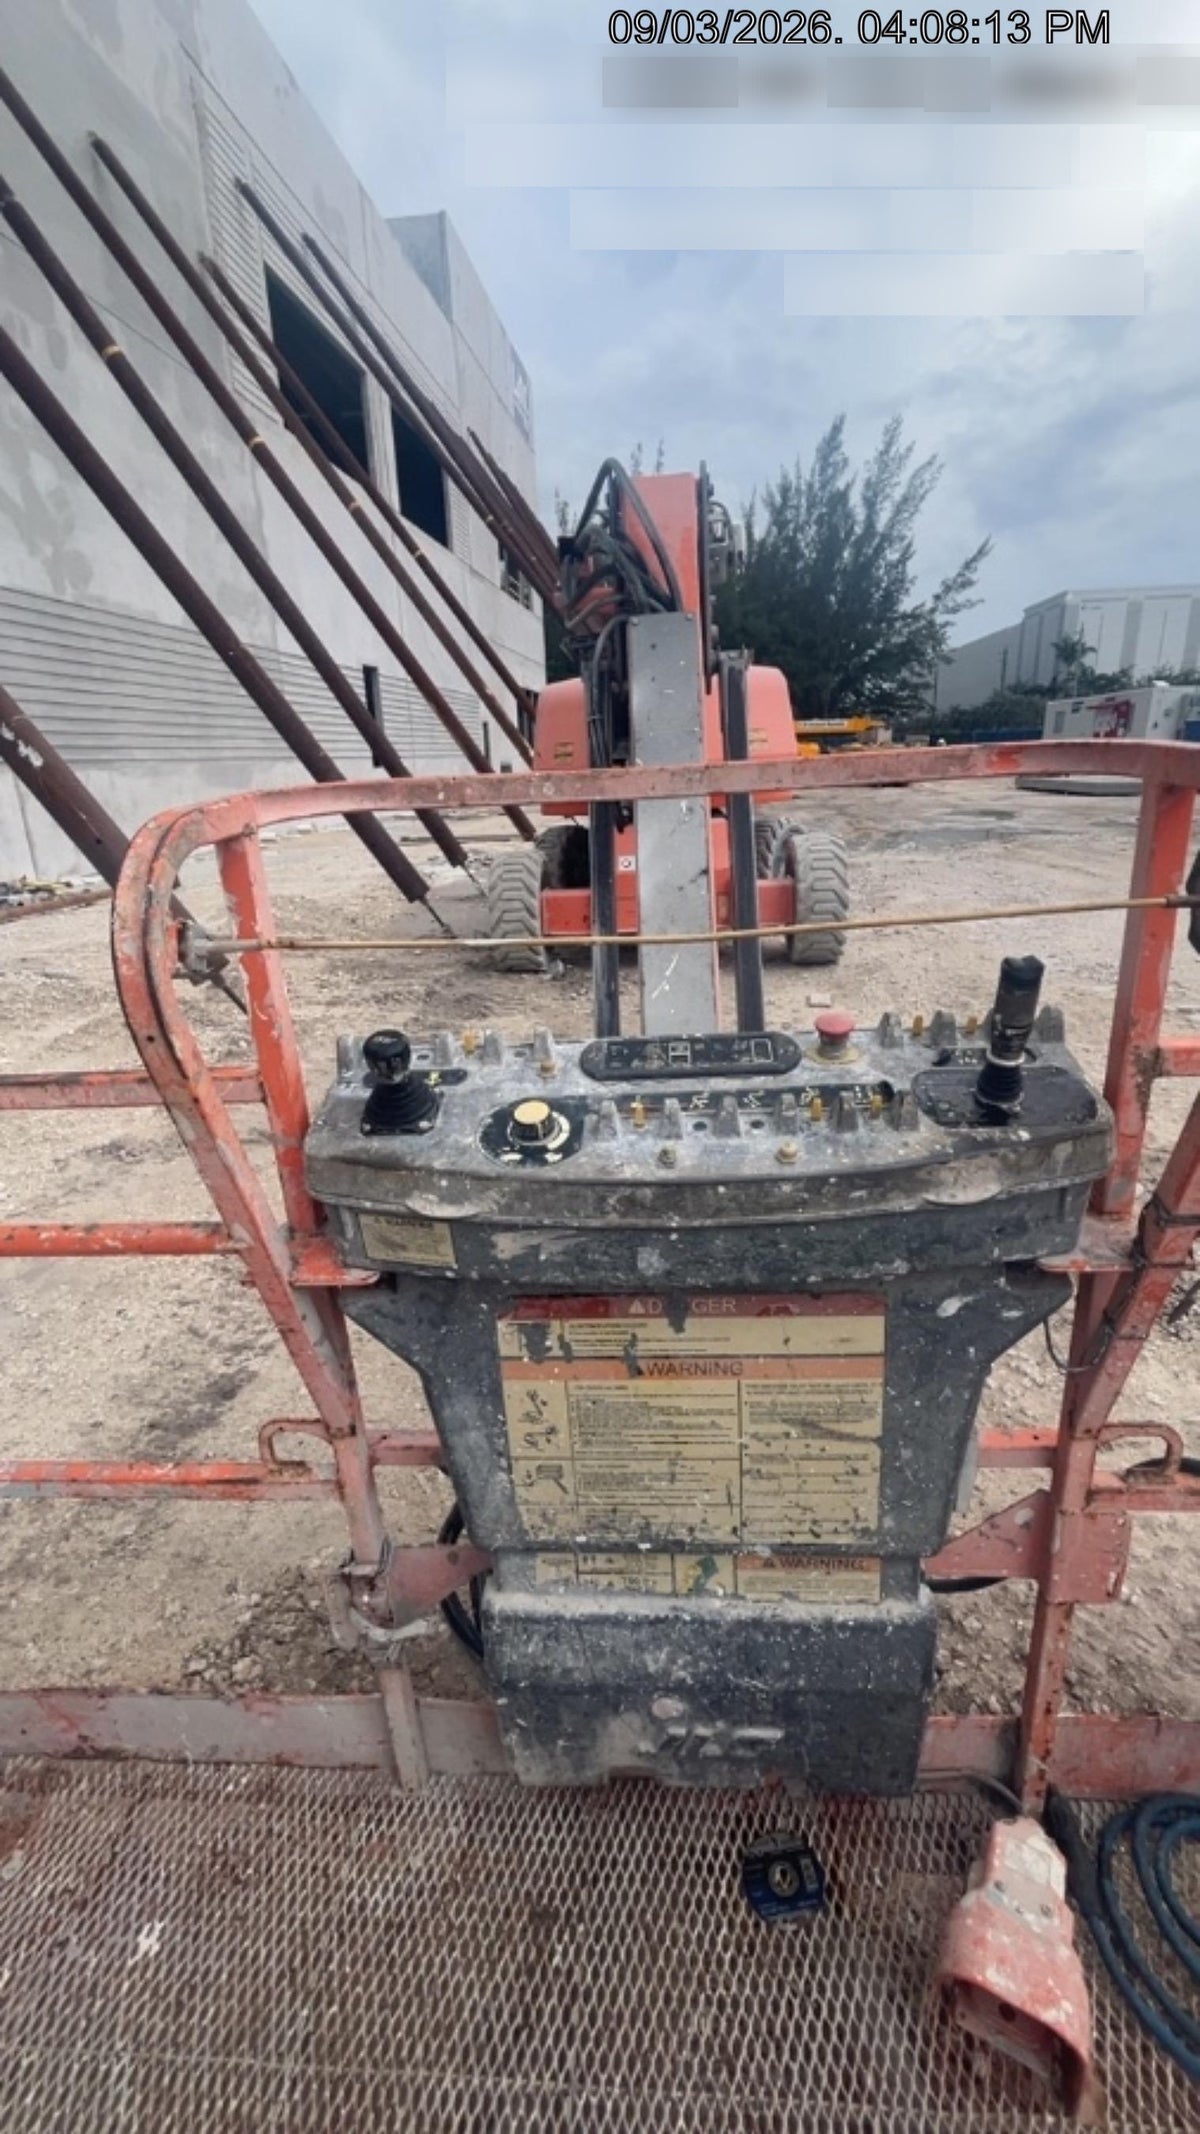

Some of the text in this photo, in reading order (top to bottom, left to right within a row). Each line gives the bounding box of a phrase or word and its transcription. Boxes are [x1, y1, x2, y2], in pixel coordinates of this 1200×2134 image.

[648, 1298, 737, 1314] DGER
[646, 1361, 744, 1377] WARNING
[780, 1557, 865, 1572] WARNING
